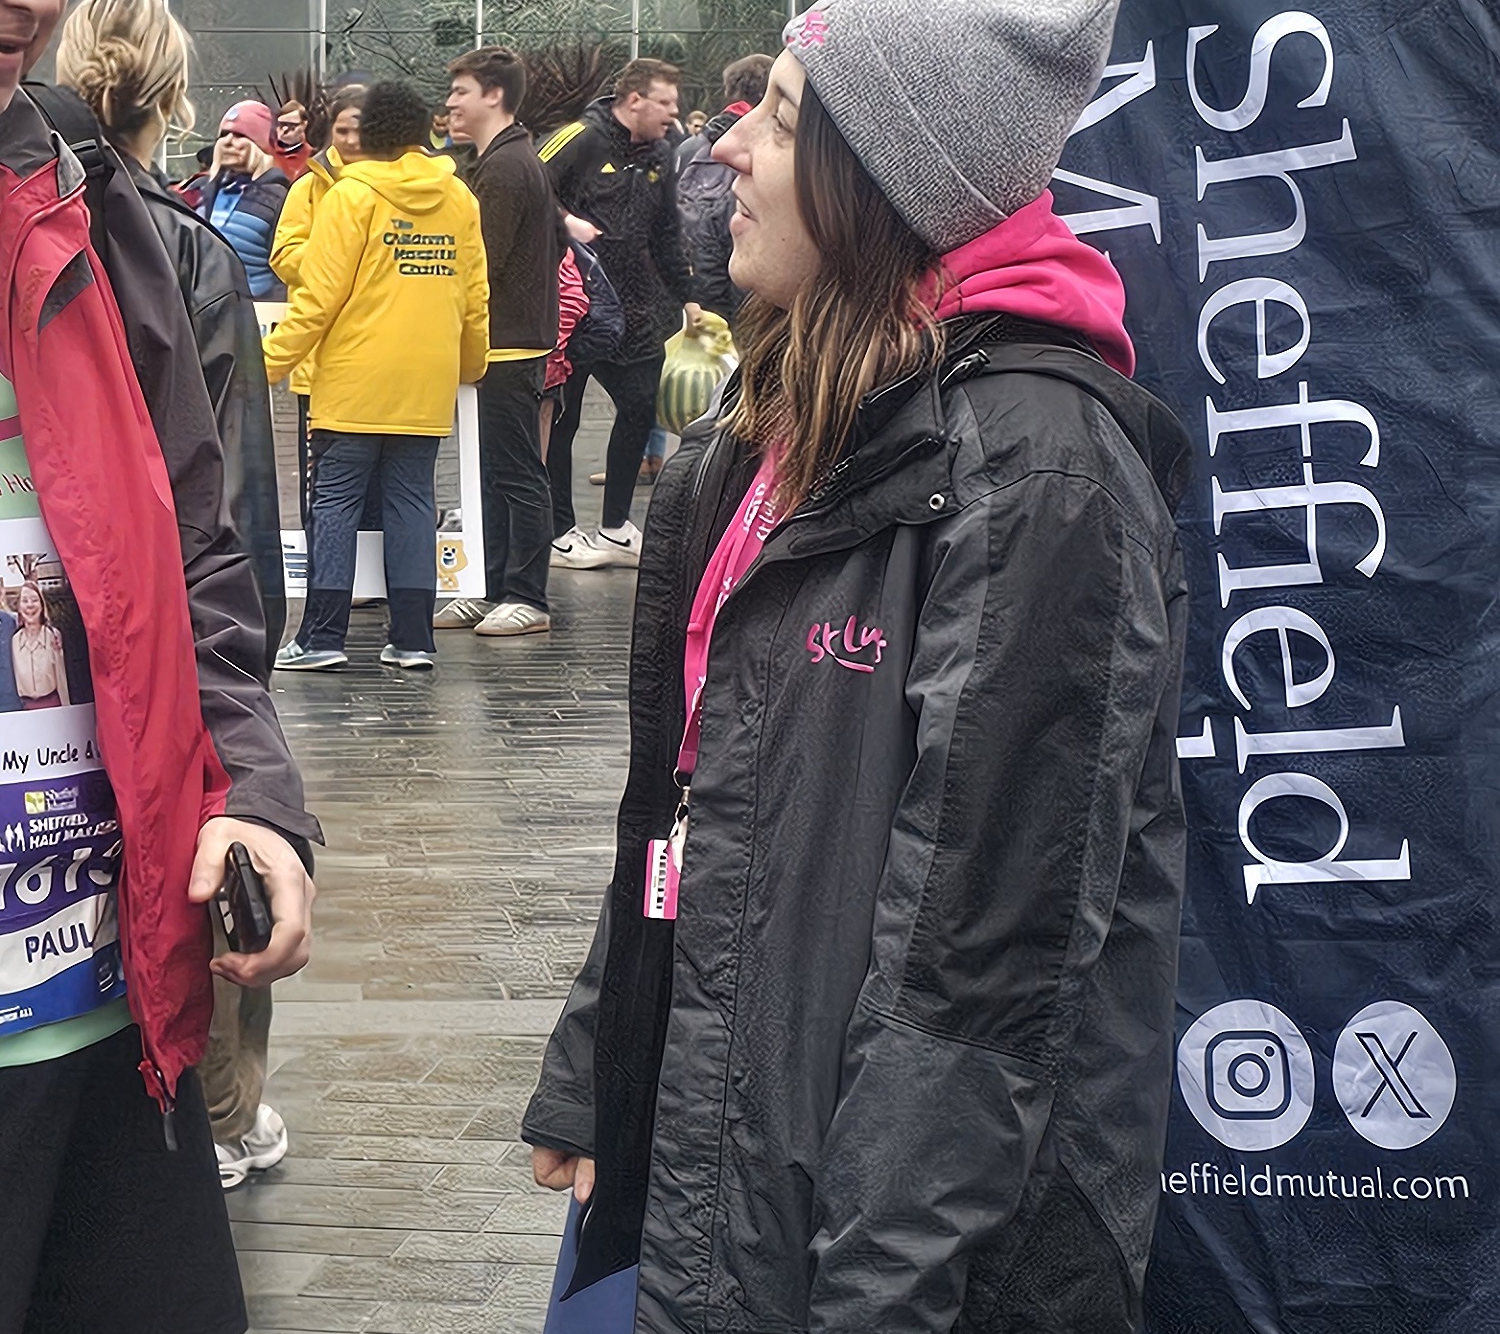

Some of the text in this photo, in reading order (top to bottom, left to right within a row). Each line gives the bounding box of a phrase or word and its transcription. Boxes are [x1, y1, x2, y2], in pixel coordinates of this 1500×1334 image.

[1186, 10, 1411, 905] Sheffield
[2, 750, 30, 774] My
[37, 742, 79, 766] Uncle
[24, 922, 93, 963] PAUL
